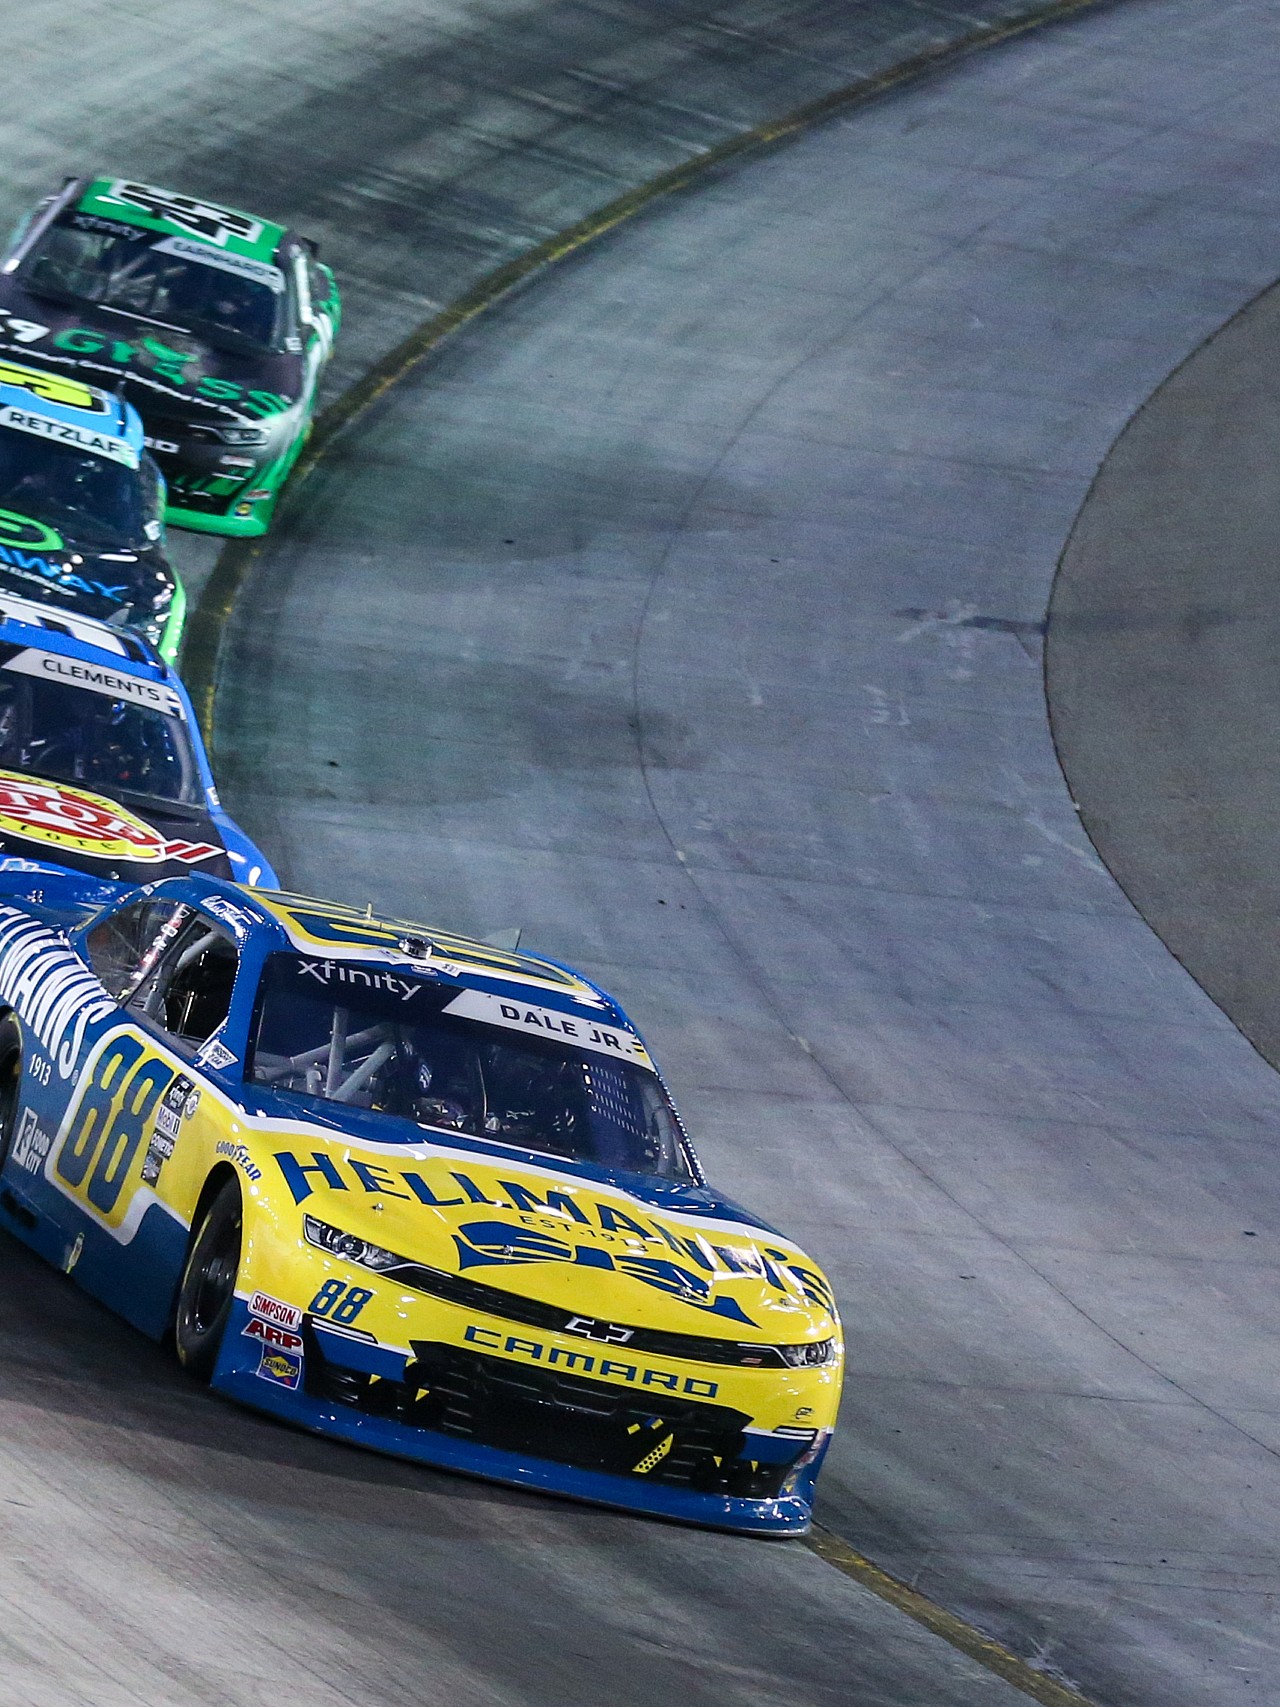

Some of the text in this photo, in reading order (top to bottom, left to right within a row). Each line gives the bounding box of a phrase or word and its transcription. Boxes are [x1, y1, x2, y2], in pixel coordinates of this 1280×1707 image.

[42, 658, 162, 702] CLEMENTS
[297, 958, 423, 1001] xfinity
[499, 1003, 632, 1055] DALE JR.
[28, 1052, 52, 1086] 1913
[57, 1034, 175, 1215] 88
[252, 1295, 297, 1327] SIMPSON
[307, 1278, 373, 1325] 88
[245, 1319, 303, 1350] ARP
[262, 1358, 298, 1376] SUNOCO
[464, 1324, 719, 1399] CAMARO
